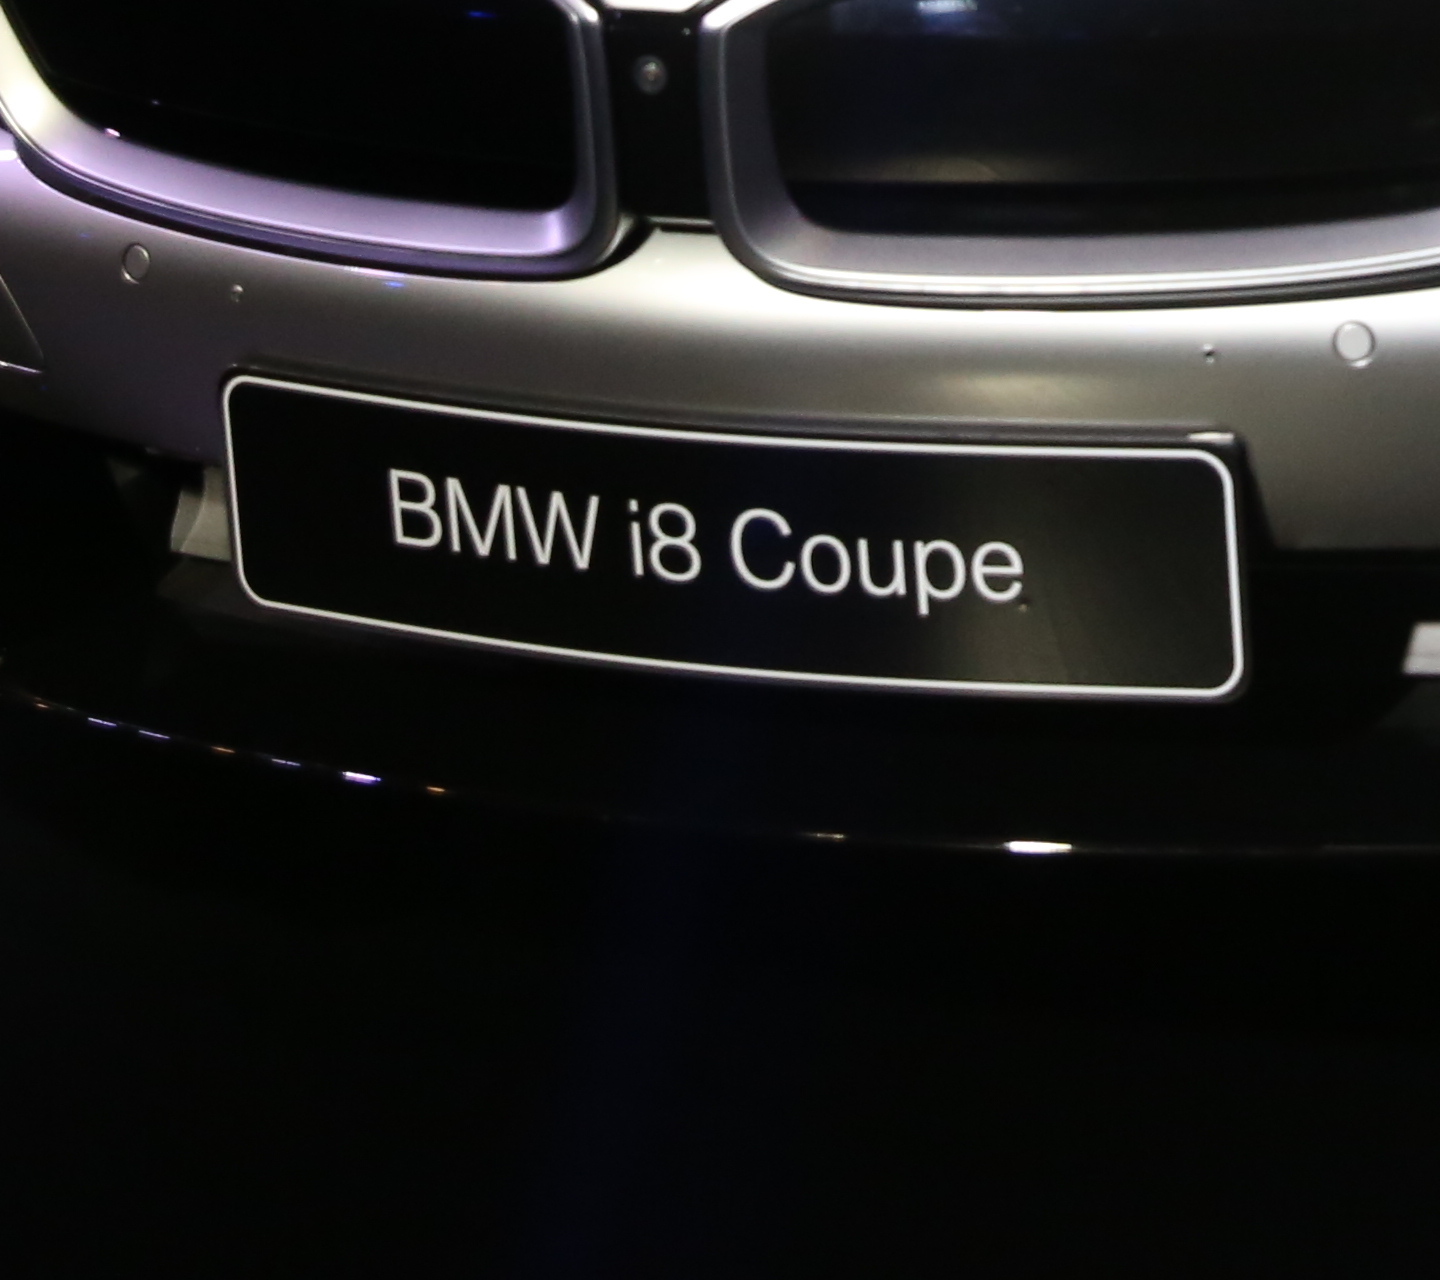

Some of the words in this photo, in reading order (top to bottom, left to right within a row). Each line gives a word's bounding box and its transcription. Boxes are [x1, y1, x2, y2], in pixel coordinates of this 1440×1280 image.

[388, 467, 600, 571] BMW
[628, 498, 703, 583] i8
[729, 507, 1025, 617] Coupe
